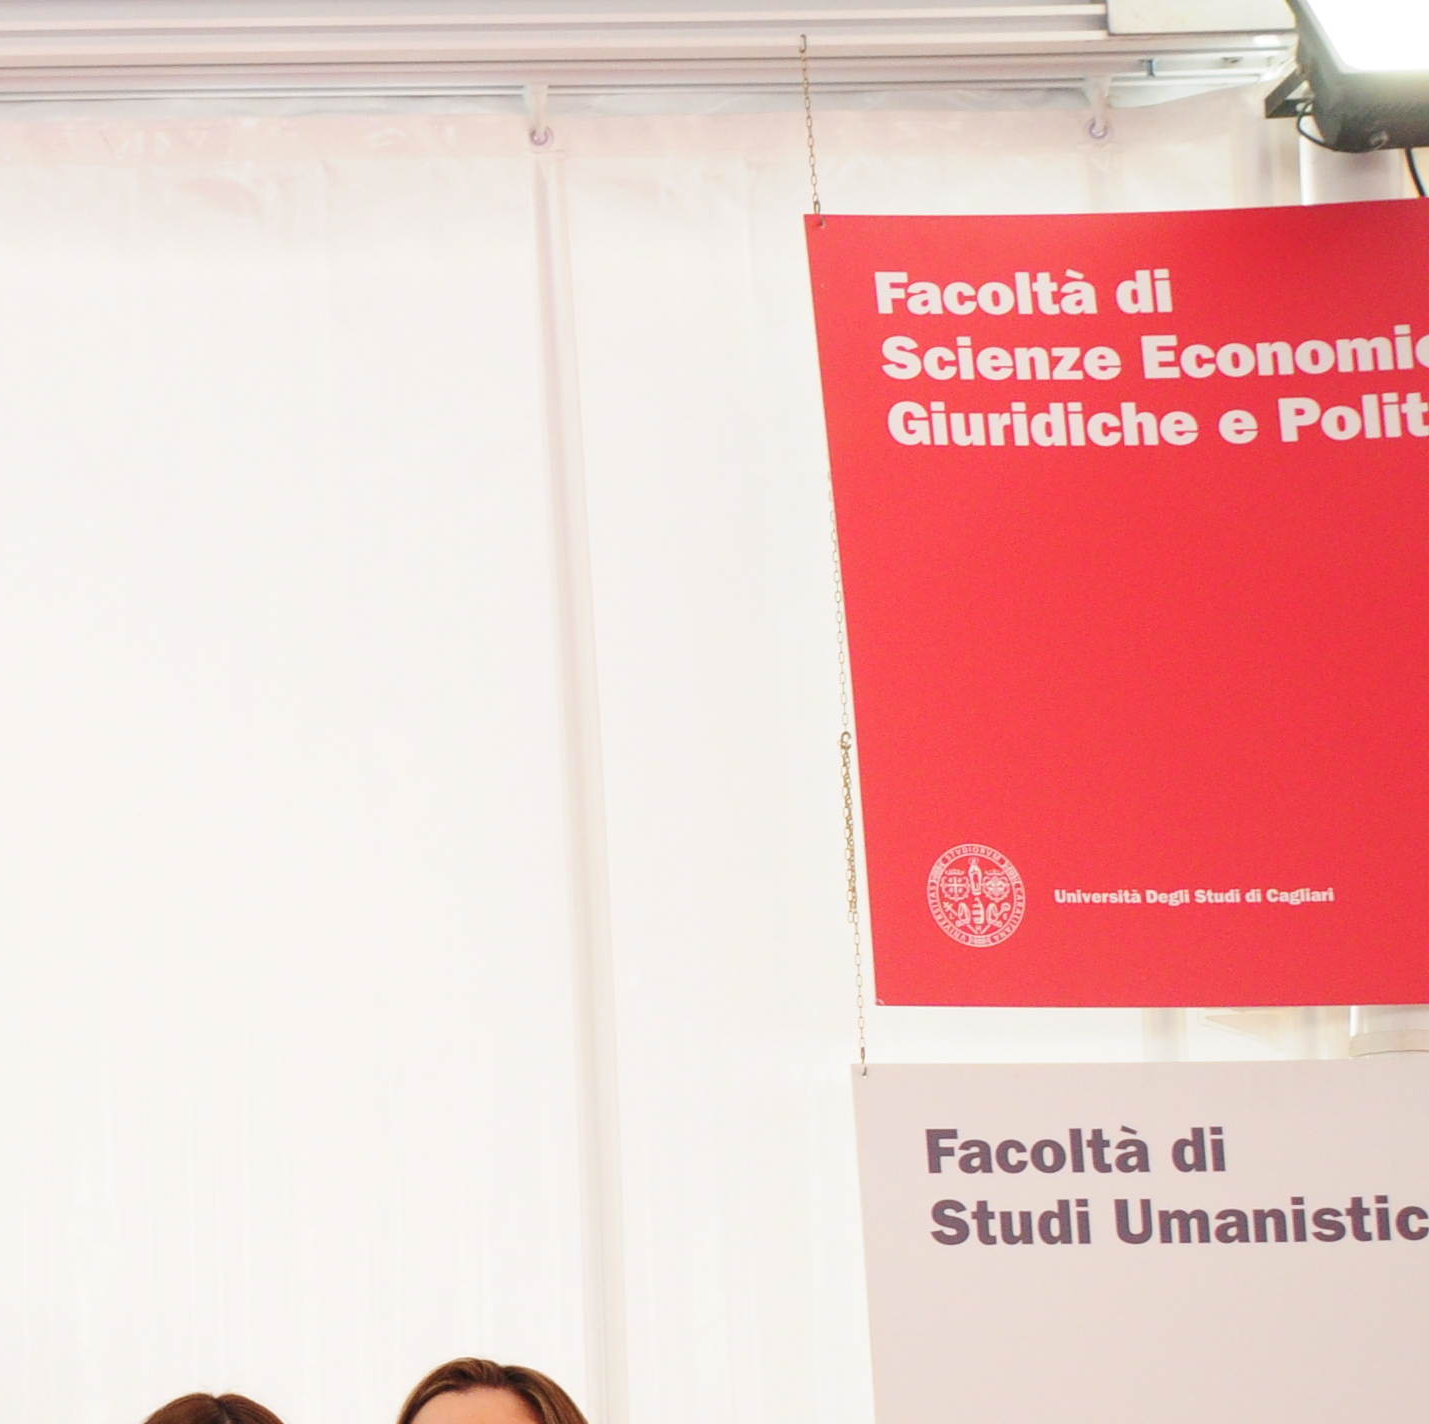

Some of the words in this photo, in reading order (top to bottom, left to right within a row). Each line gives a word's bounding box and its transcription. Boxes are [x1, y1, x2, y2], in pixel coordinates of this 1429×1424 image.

[875, 269, 1098, 316] Facoltà
[1117, 268, 1173, 314] di
[882, 335, 1122, 381] Scienze
[887, 400, 1198, 447] Giuridiche
[1218, 409, 1258, 444] e
[1054, 888, 1142, 904] Università
[1146, 888, 1189, 907] Degli
[1195, 888, 1241, 904] Studi
[1245, 888, 1262, 903] di
[1267, 887, 1334, 906] Cagliari
[926, 1125, 1151, 1174] Facoltà
[1172, 1126, 1226, 1173] di
[931, 1198, 1091, 1246] Studi
[1115, 1194, 1429, 1245] Umanistic
